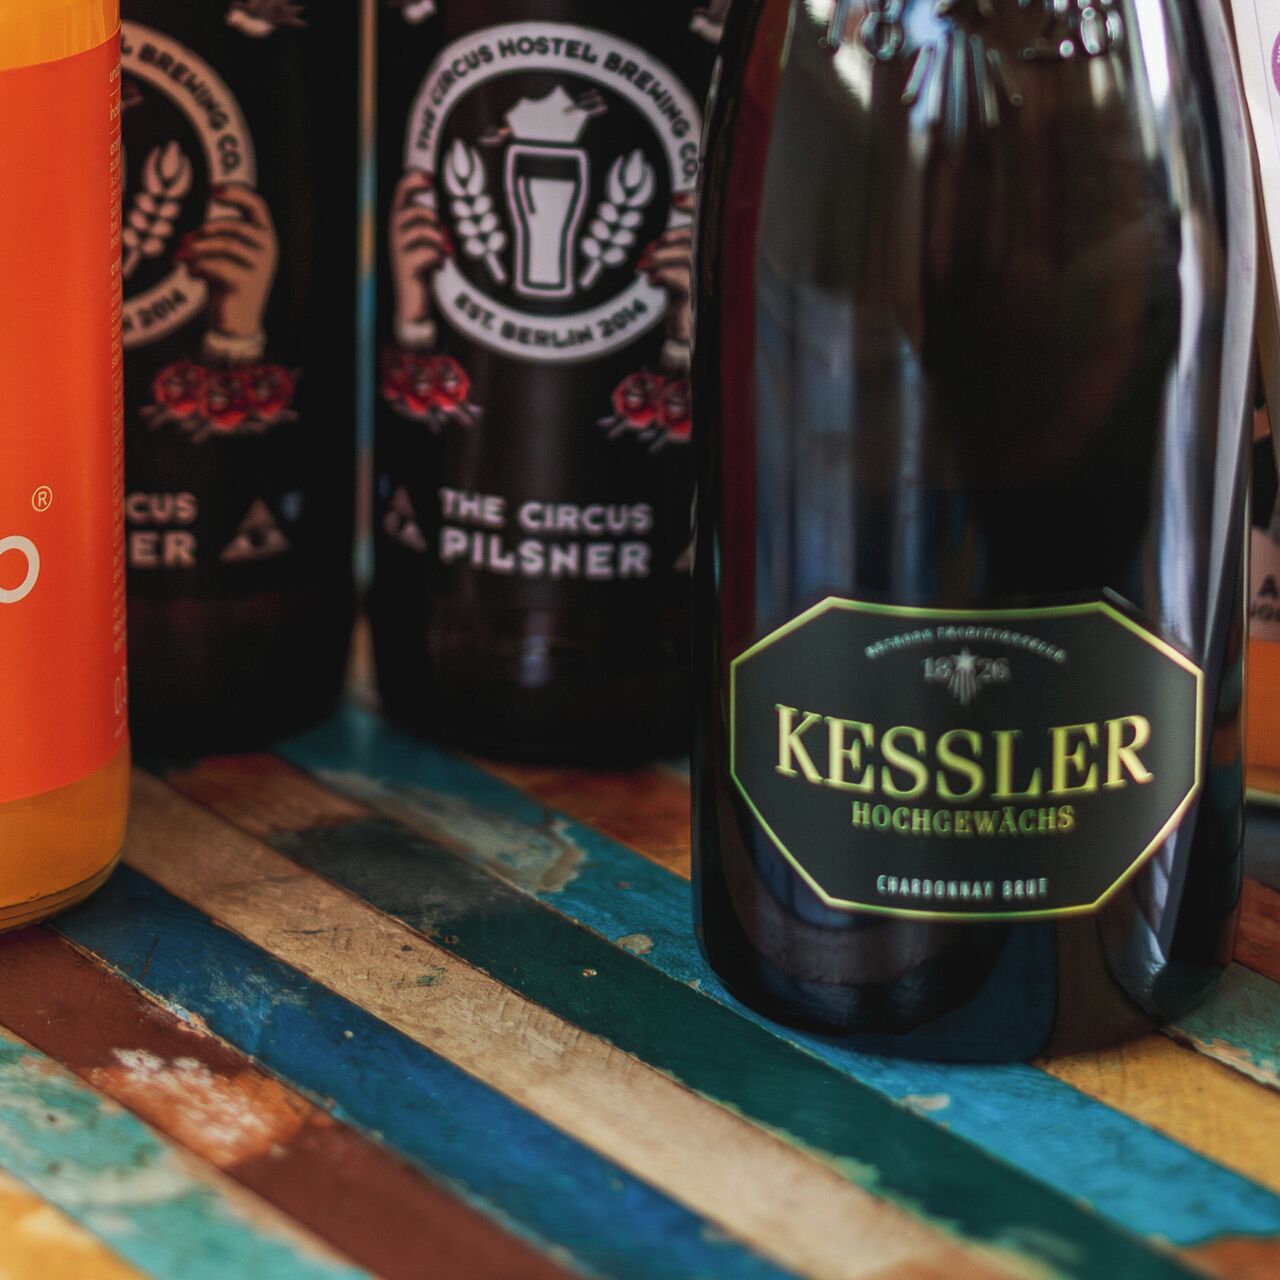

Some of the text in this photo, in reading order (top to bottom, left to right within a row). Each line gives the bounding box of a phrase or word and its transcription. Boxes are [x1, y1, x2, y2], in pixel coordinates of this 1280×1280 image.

[431, 37, 690, 138] CIRCUS HOSTEL BREWING
[501, 298, 649, 348] BERLIN 2014
[125, 492, 197, 522] CUS
[439, 487, 652, 535] THE CIRCUS
[440, 527, 650, 578] PILSNER
[775, 703, 1153, 803] KESSLER
[851, 801, 1075, 834] HOCHGEWÄCHS
[877, 875, 1049, 898] CHARDONNAY BRUT
